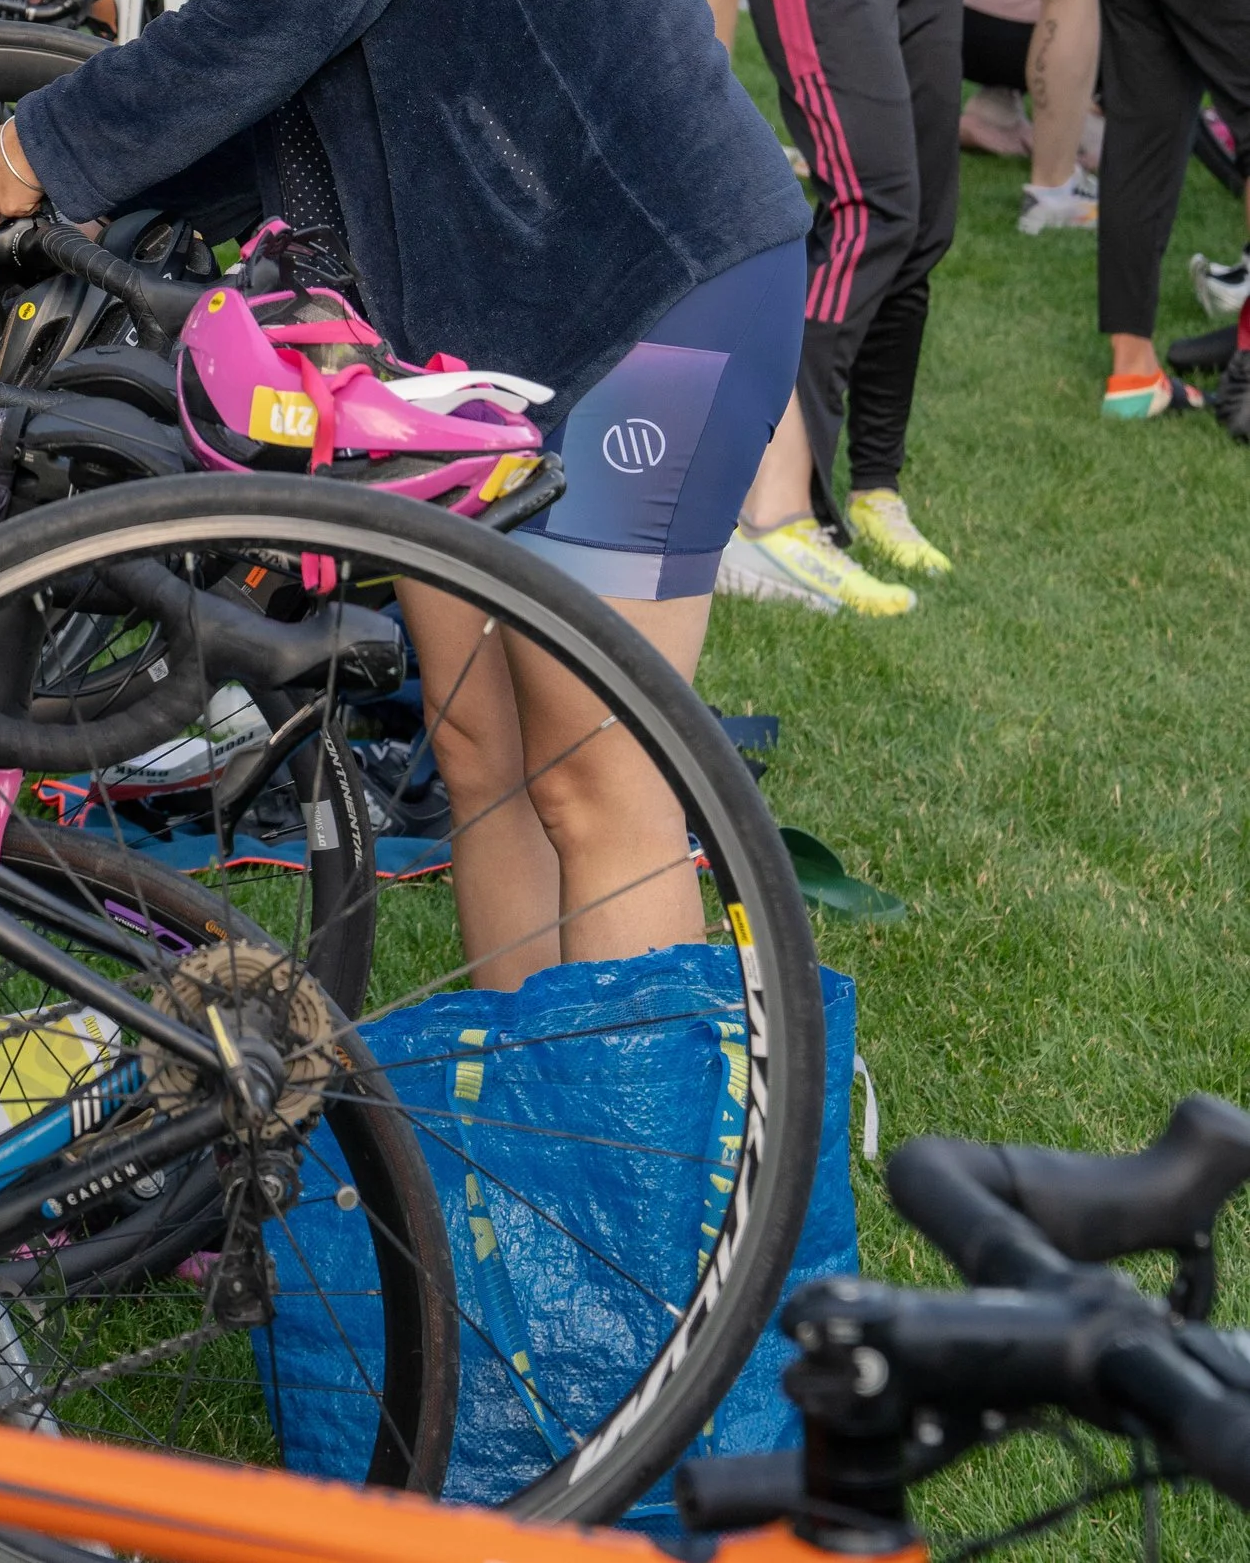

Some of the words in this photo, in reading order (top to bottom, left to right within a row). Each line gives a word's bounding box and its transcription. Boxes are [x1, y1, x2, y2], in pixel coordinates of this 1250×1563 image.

[270, 405, 314, 436] 279
[317, 833, 327, 847] DT
[113, 915, 148, 936] MADDUX
